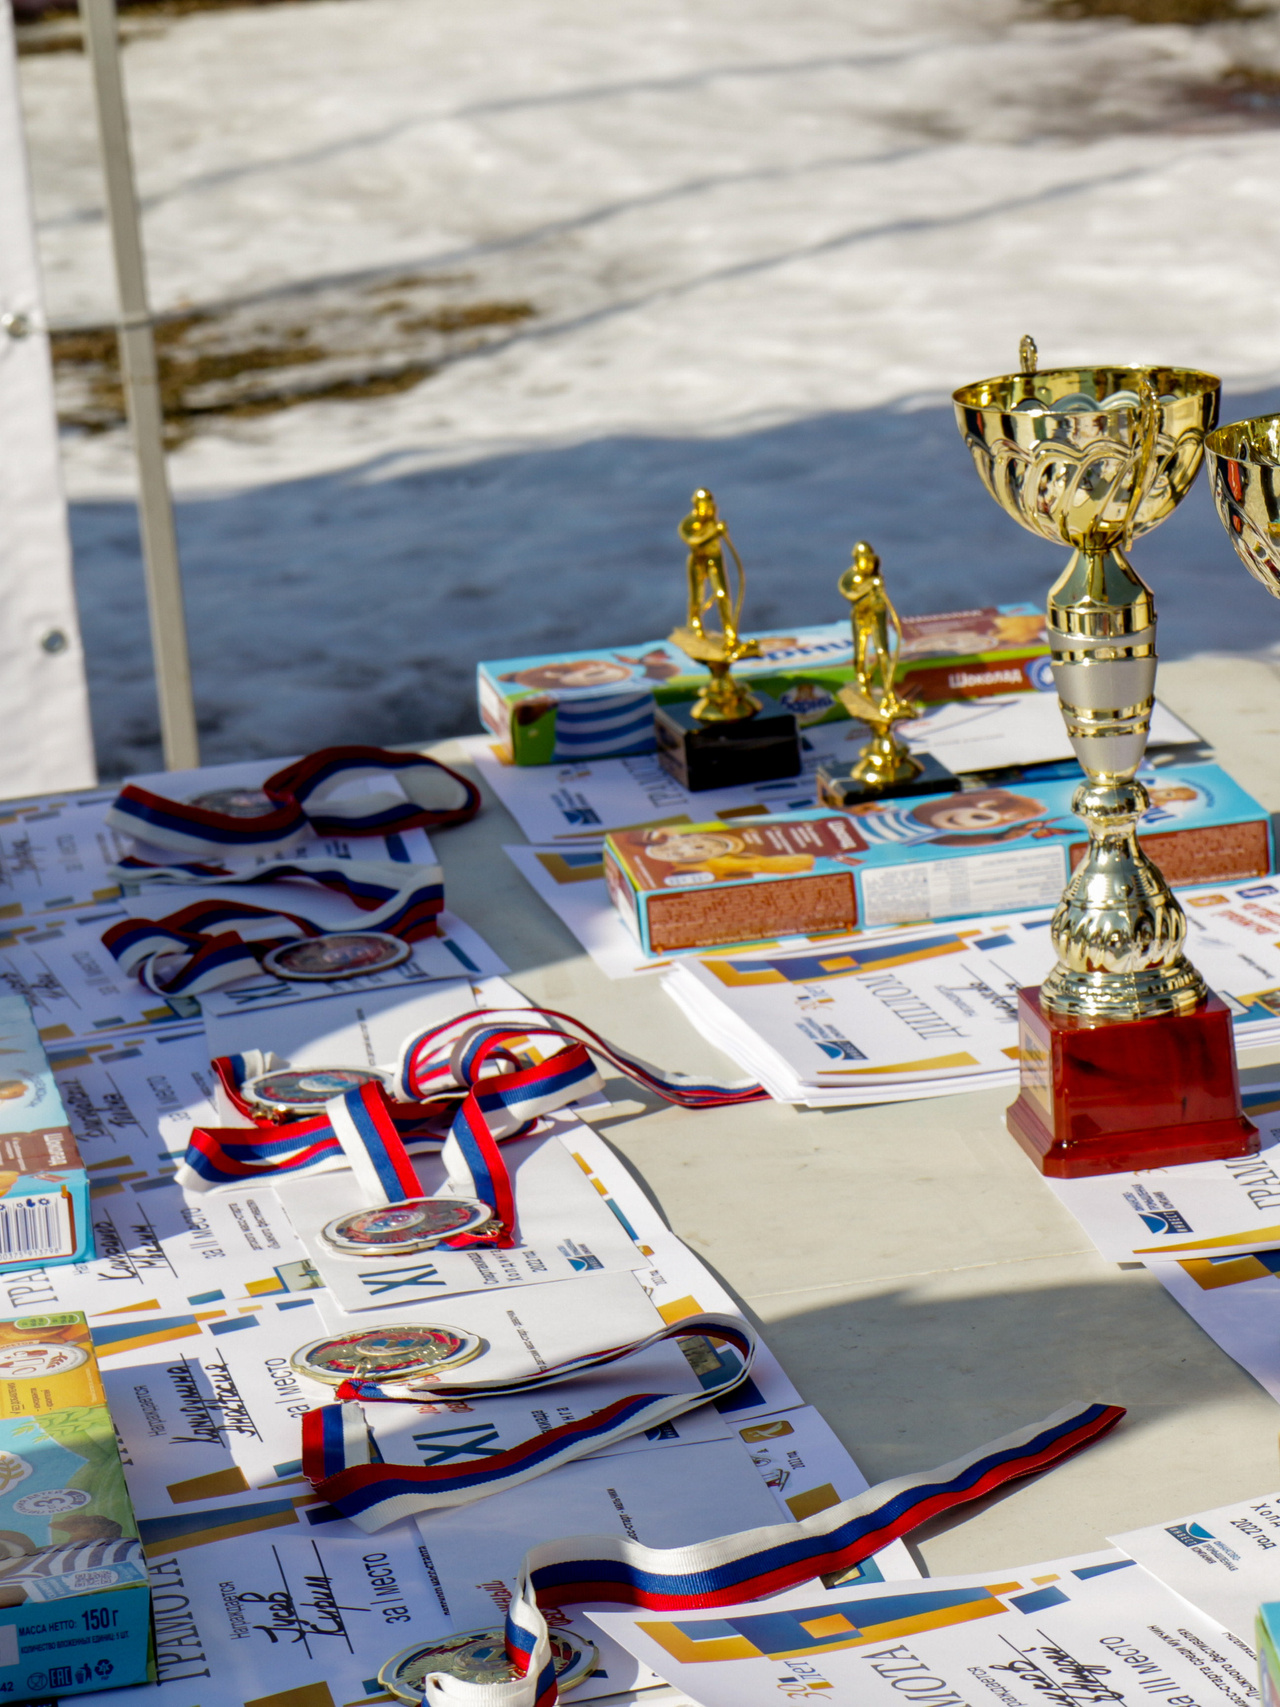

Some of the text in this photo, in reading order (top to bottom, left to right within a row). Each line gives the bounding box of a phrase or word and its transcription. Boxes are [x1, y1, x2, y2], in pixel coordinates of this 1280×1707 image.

[949, 669, 1022, 689] Шоколад
[856, 974, 973, 1040] ДИПЛОМ
[357, 1263, 447, 1296] XI
[265, 1358, 302, 1396] место
[134, 1385, 166, 1437] Награждается
[1169, 1527, 1198, 1547] ИНВЕСТ
[1230, 1518, 1277, 1550] 2022 год
[362, 1552, 401, 1597] место
[82, 1607, 119, 1631] 150 г
[219, 1581, 250, 1640] Награждается
[238, 1592, 310, 1643] Гусев
[385, 1606, 412, 1623] за
[19, 1619, 77, 1637] МАССА НЕТТО:
[20, 1642, 56, 1654] КОЛИЧЕСТВО
[57, 1637, 91, 1650] ВЛОЖЕННЫХ
[1147, 1625, 1182, 1651] мужчин
[1177, 1648, 1204, 1667] среди
[1177, 1628, 1227, 1664] фестиваля»
[784, 1661, 823, 1681] лет
[861, 1644, 971, 1707] МОТА
[1099, 1636, 1162, 1675] место
[1139, 1677, 1180, 1694] III
[0, 1681, 14, 1693] 42
